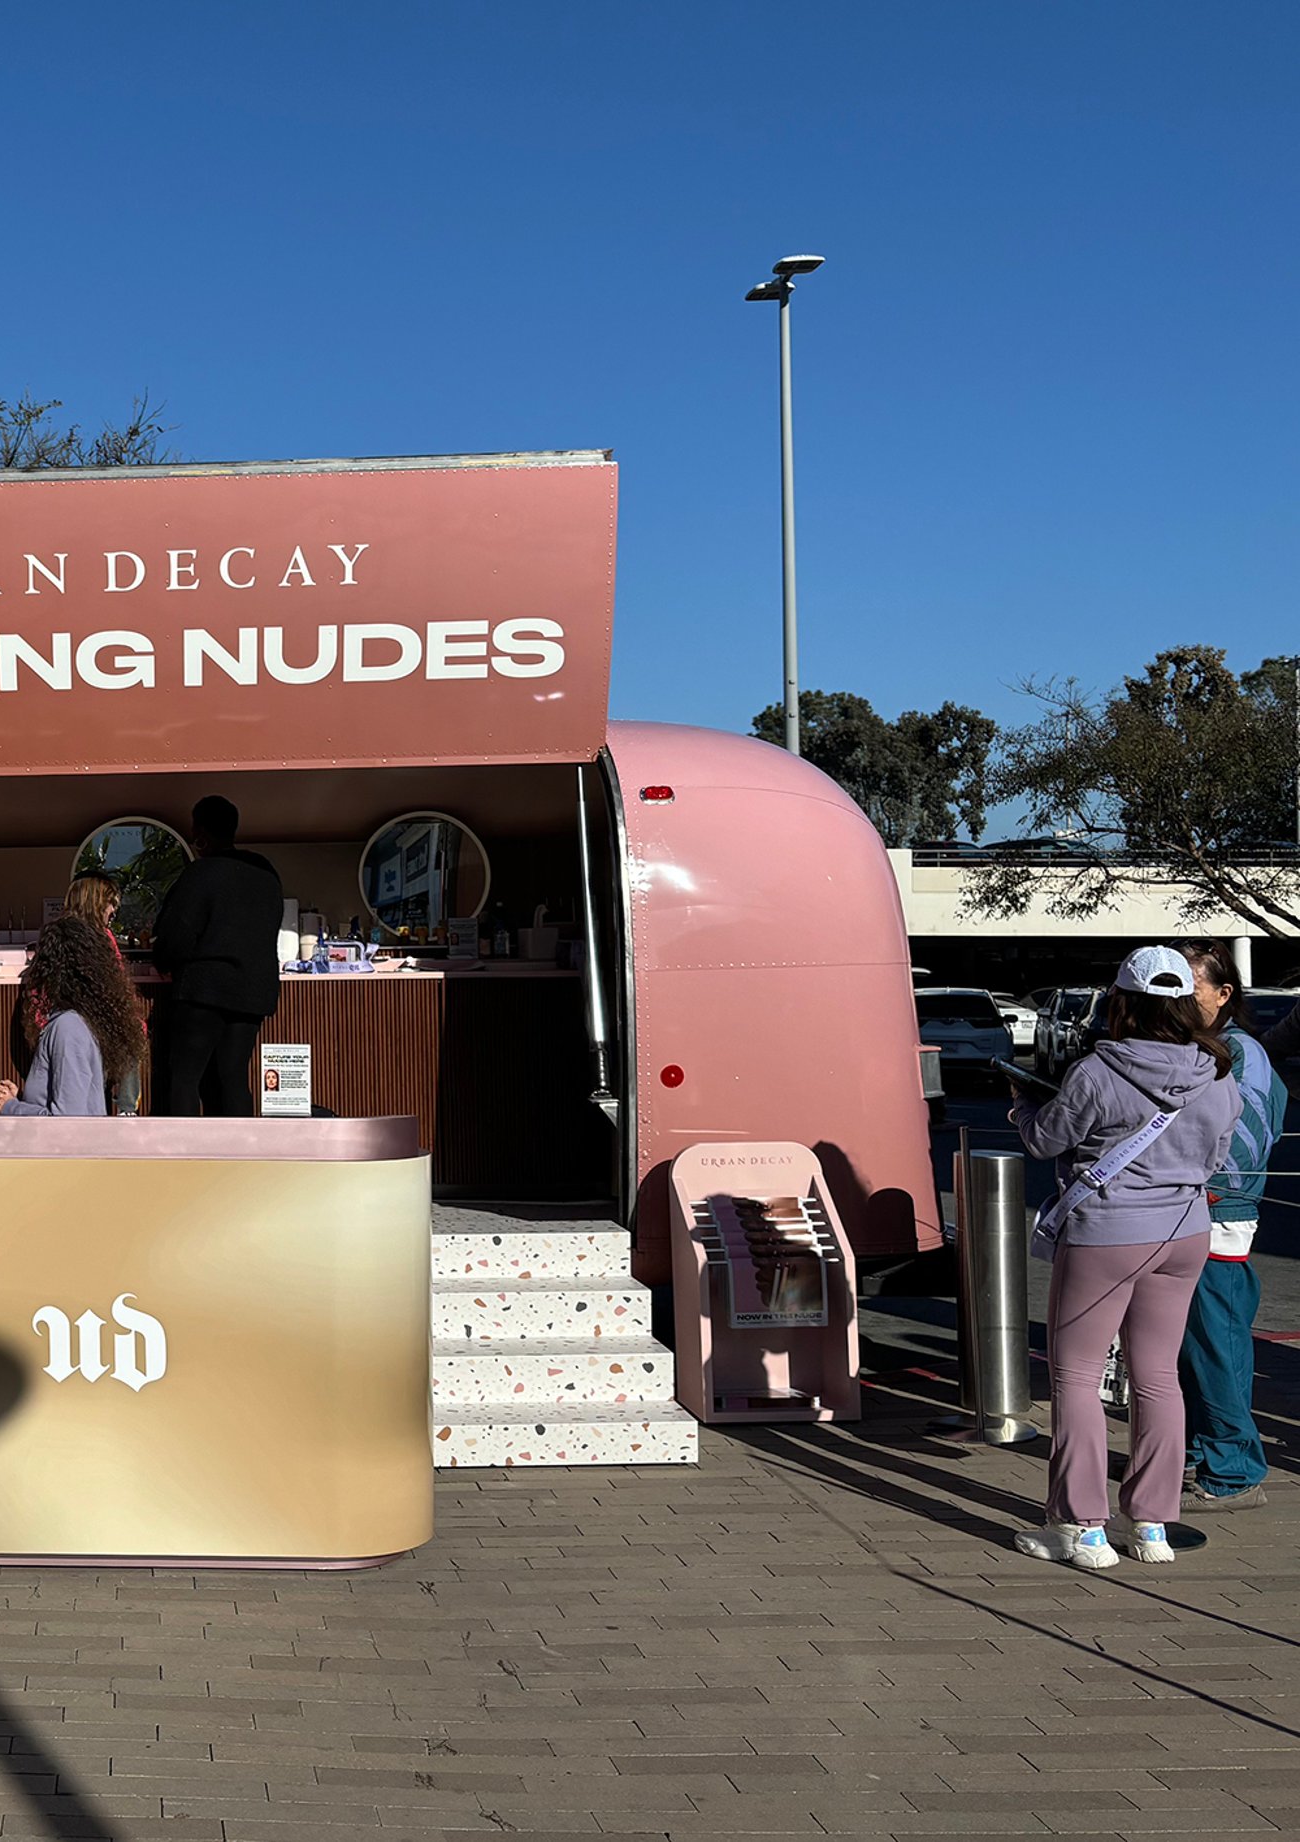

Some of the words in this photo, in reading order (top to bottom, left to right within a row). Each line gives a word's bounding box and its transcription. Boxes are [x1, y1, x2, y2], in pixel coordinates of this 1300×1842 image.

[103, 543, 370, 592] DECAY
[183, 617, 565, 687] NUDES
[701, 1157, 746, 1168] URBAN
[750, 1156, 793, 1165] DECAY
